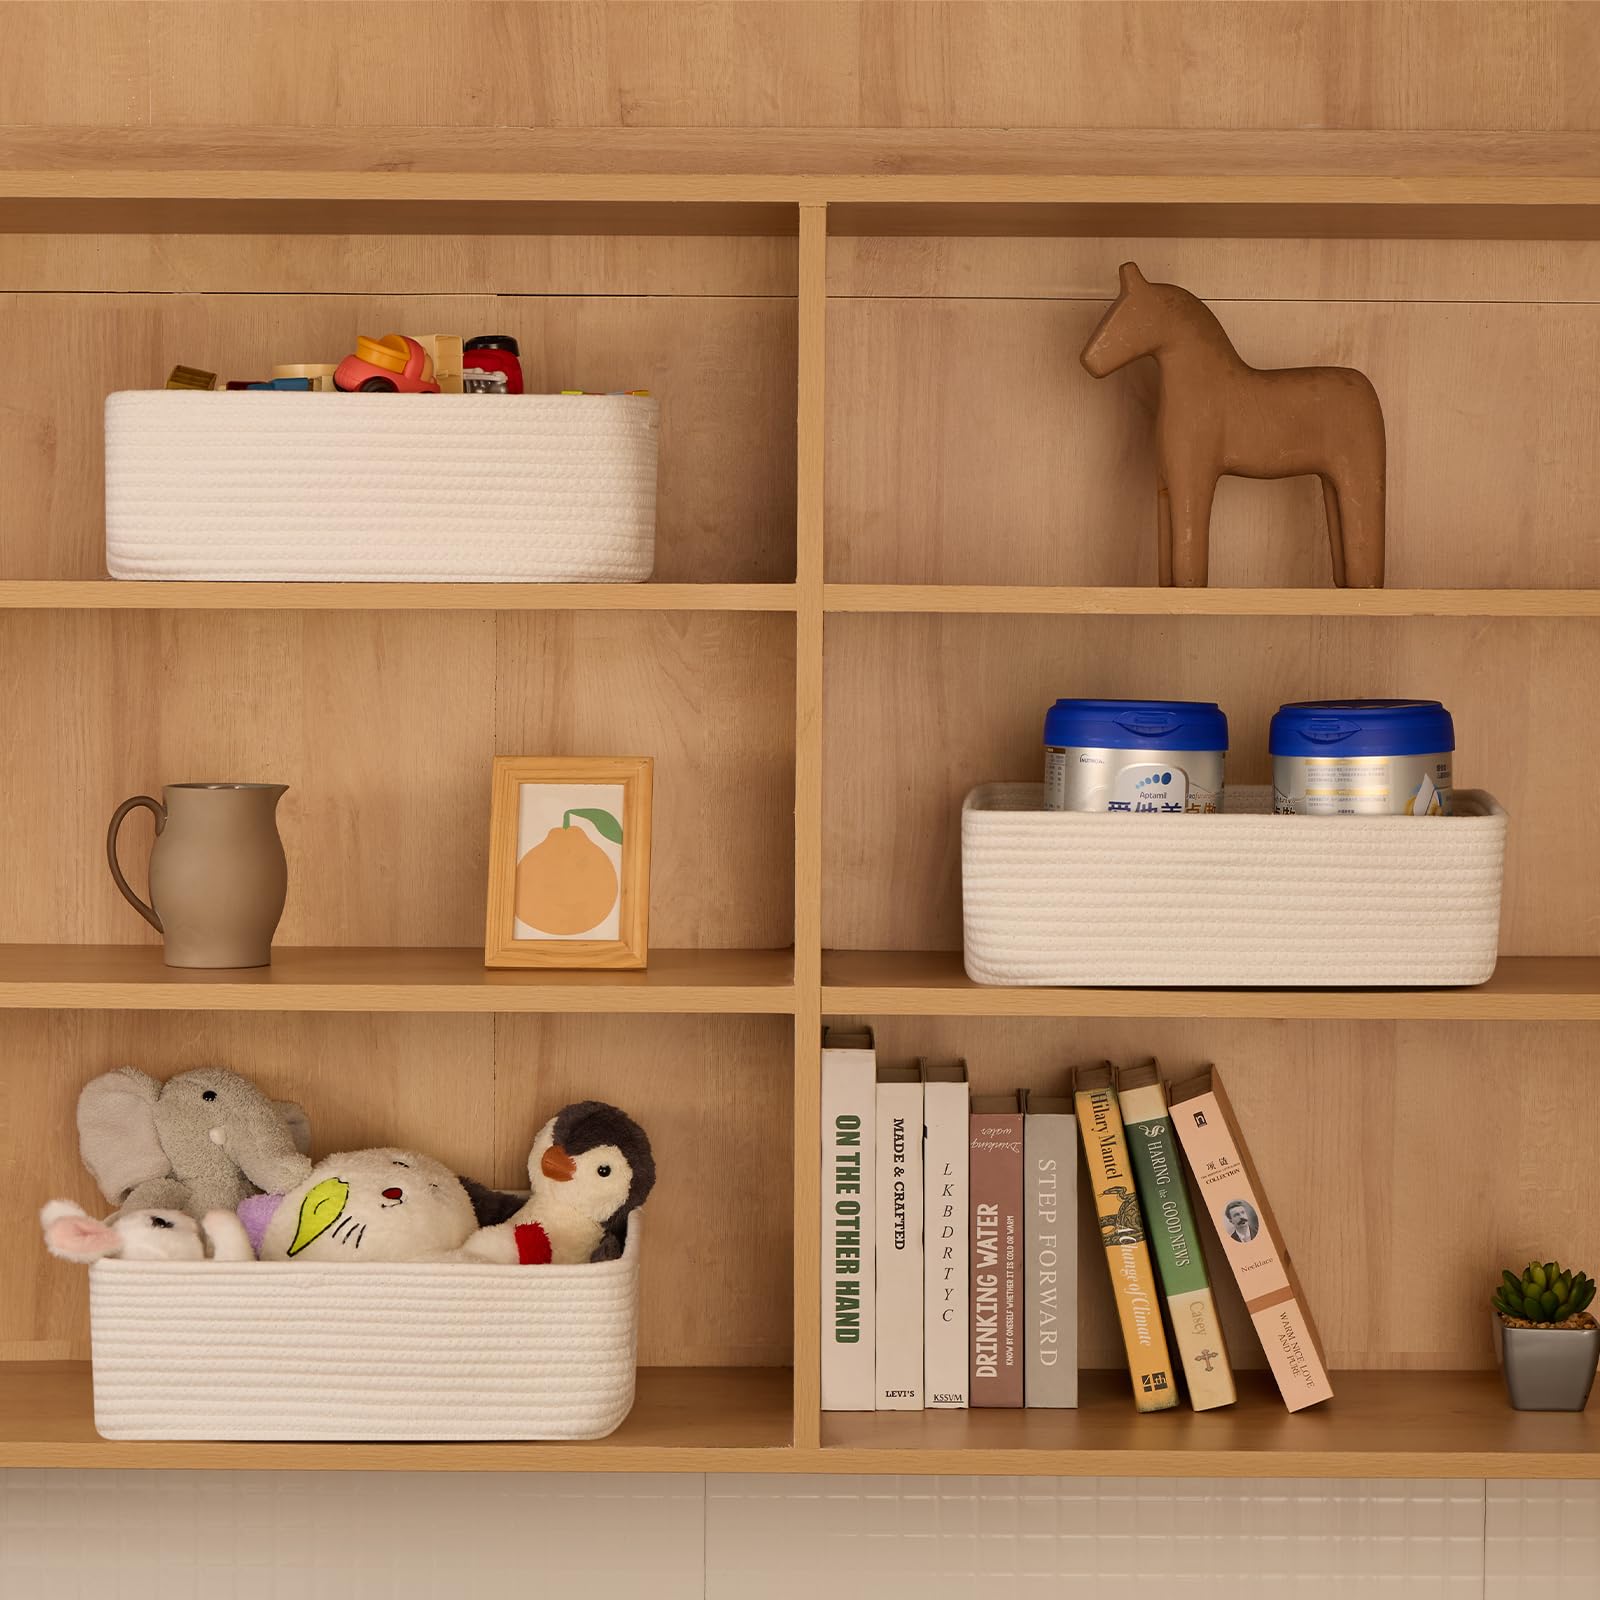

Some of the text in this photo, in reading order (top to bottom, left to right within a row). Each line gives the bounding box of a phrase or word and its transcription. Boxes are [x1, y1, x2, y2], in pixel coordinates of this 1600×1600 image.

[1139, 791, 1168, 800] Aptamil
[970, 1138, 1022, 1154] Drinking
[1090, 1092, 1123, 1181] Hilary Mantel
[893, 1118, 906, 1250] MADE & CRAFTED
[1205, 1168, 1241, 1185] COLLECTION
[1158, 1188, 1168, 1199] the
[835, 1114, 861, 1344] ON THE OTHER HAND
[1006, 1215, 1015, 1235] WARM
[1162, 1201, 1182, 1234] GOOD
[1006, 1235, 1015, 1244] OR
[1006, 1245, 1015, 1261] COLD
[1169, 1233, 1190, 1267] NEWS
[1006, 1261, 1015, 1269] IS
[1038, 1159, 1059, 1367] STEP FORWARD
[1119, 1235, 1139, 1282] Change
[1240, 1256, 1274, 1273] Necklace
[1006, 1270, 1015, 1278] IT
[975, 1203, 999, 1378] DRINKING WATER
[1006, 1279, 1015, 1309] WHETHER
[1123, 1282, 1148, 1298] of
[1006, 1310, 1015, 1337] ONESELF
[1132, 1297, 1152, 1347] Climate
[1190, 1300, 1208, 1336] Casey
[1006, 1346, 1015, 1366] KNOW
[1278, 1334, 1300, 1378] AND PURE
[1280, 1311, 1315, 1389] WARM NICE LOVE
[885, 1390, 915, 1398] LEVI'S
